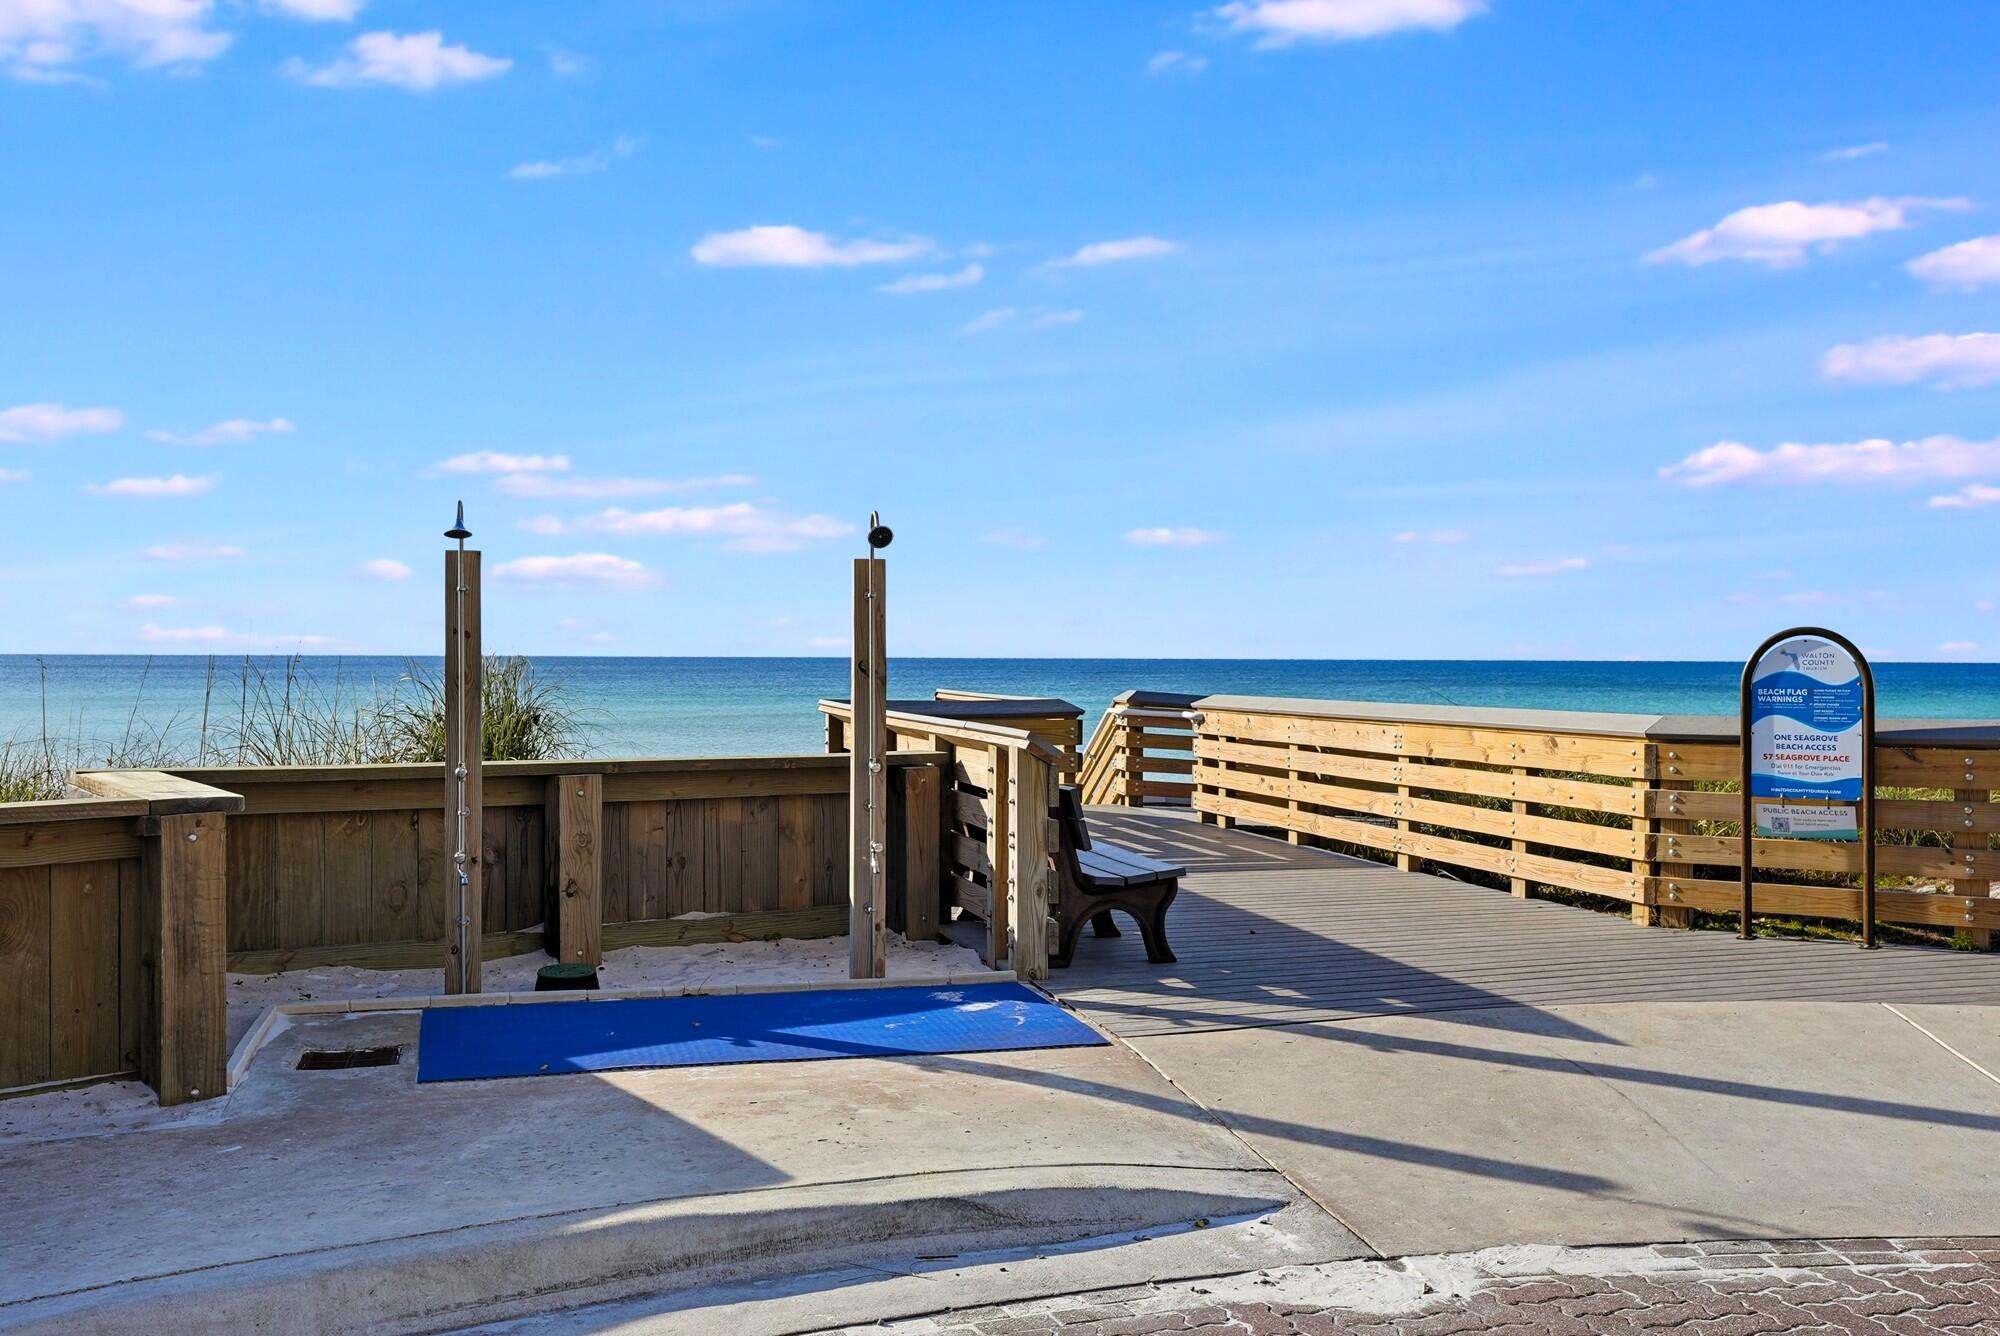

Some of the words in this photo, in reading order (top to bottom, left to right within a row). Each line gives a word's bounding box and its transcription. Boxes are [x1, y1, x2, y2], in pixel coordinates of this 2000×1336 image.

[1758, 688, 1785, 696] BEACH
[1787, 688, 1808, 696] FLAG
[1775, 753, 1820, 762] SEAGROVE
[1823, 755, 1850, 763] PLACE
[1763, 807, 1789, 815] PUBLIC
